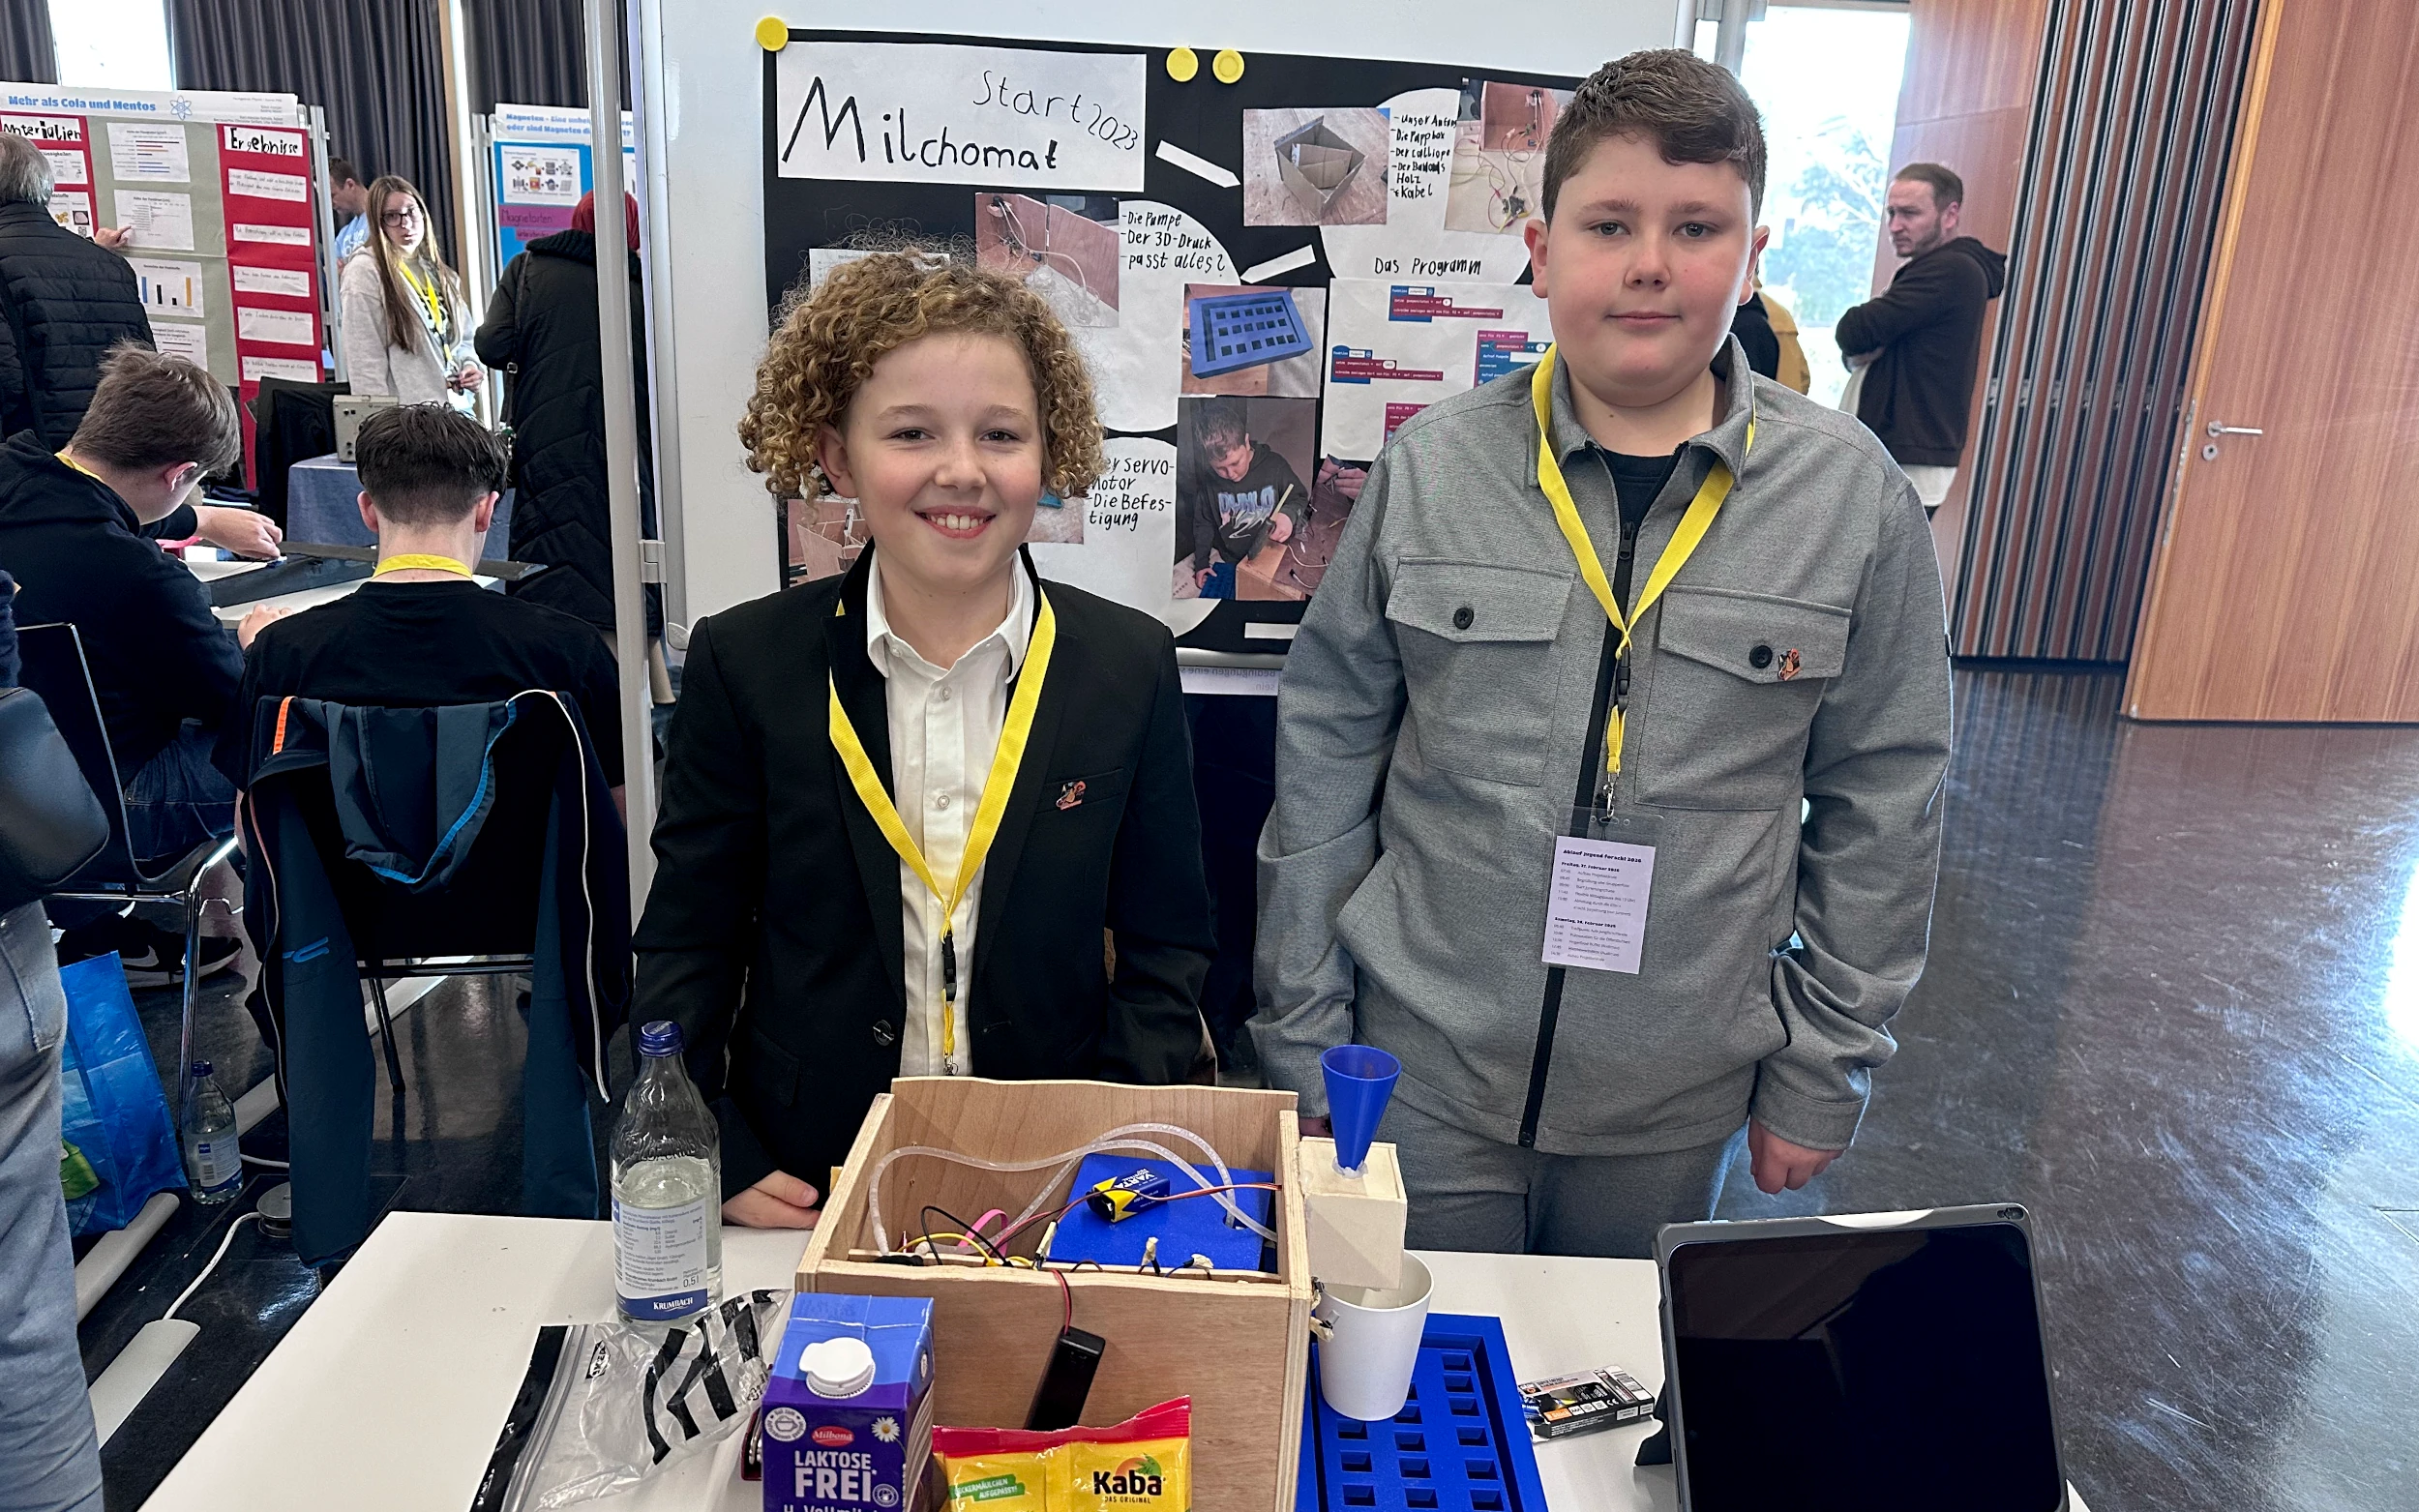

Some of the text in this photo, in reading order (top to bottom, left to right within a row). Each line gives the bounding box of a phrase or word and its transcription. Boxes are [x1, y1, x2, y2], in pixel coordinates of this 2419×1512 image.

[8, 95, 156, 111] Mehr als Cola und Mentos
[972, 70, 1138, 151] Start 2023
[506, 113, 544, 122] Magneten
[781, 76, 1058, 171] Milchomat
[230, 127, 298, 155] Ergebnisse
[1397, 173, 1421, 183] Holz
[1146, 212, 1182, 231] Pumpe
[1155, 231, 1212, 249] 3D-Druck
[1374, 257, 1482, 278] Das Programm
[1122, 493, 1172, 511] Befes-
[1090, 511, 1138, 532] tigung
[683, 1277, 696, 1287] 0,5
[653, 1297, 693, 1310] KRUMBACH
[812, 1431, 853, 1441] Milbona
[794, 1450, 871, 1470] LAKTOSE
[1093, 1469, 1162, 1496] Kaba
